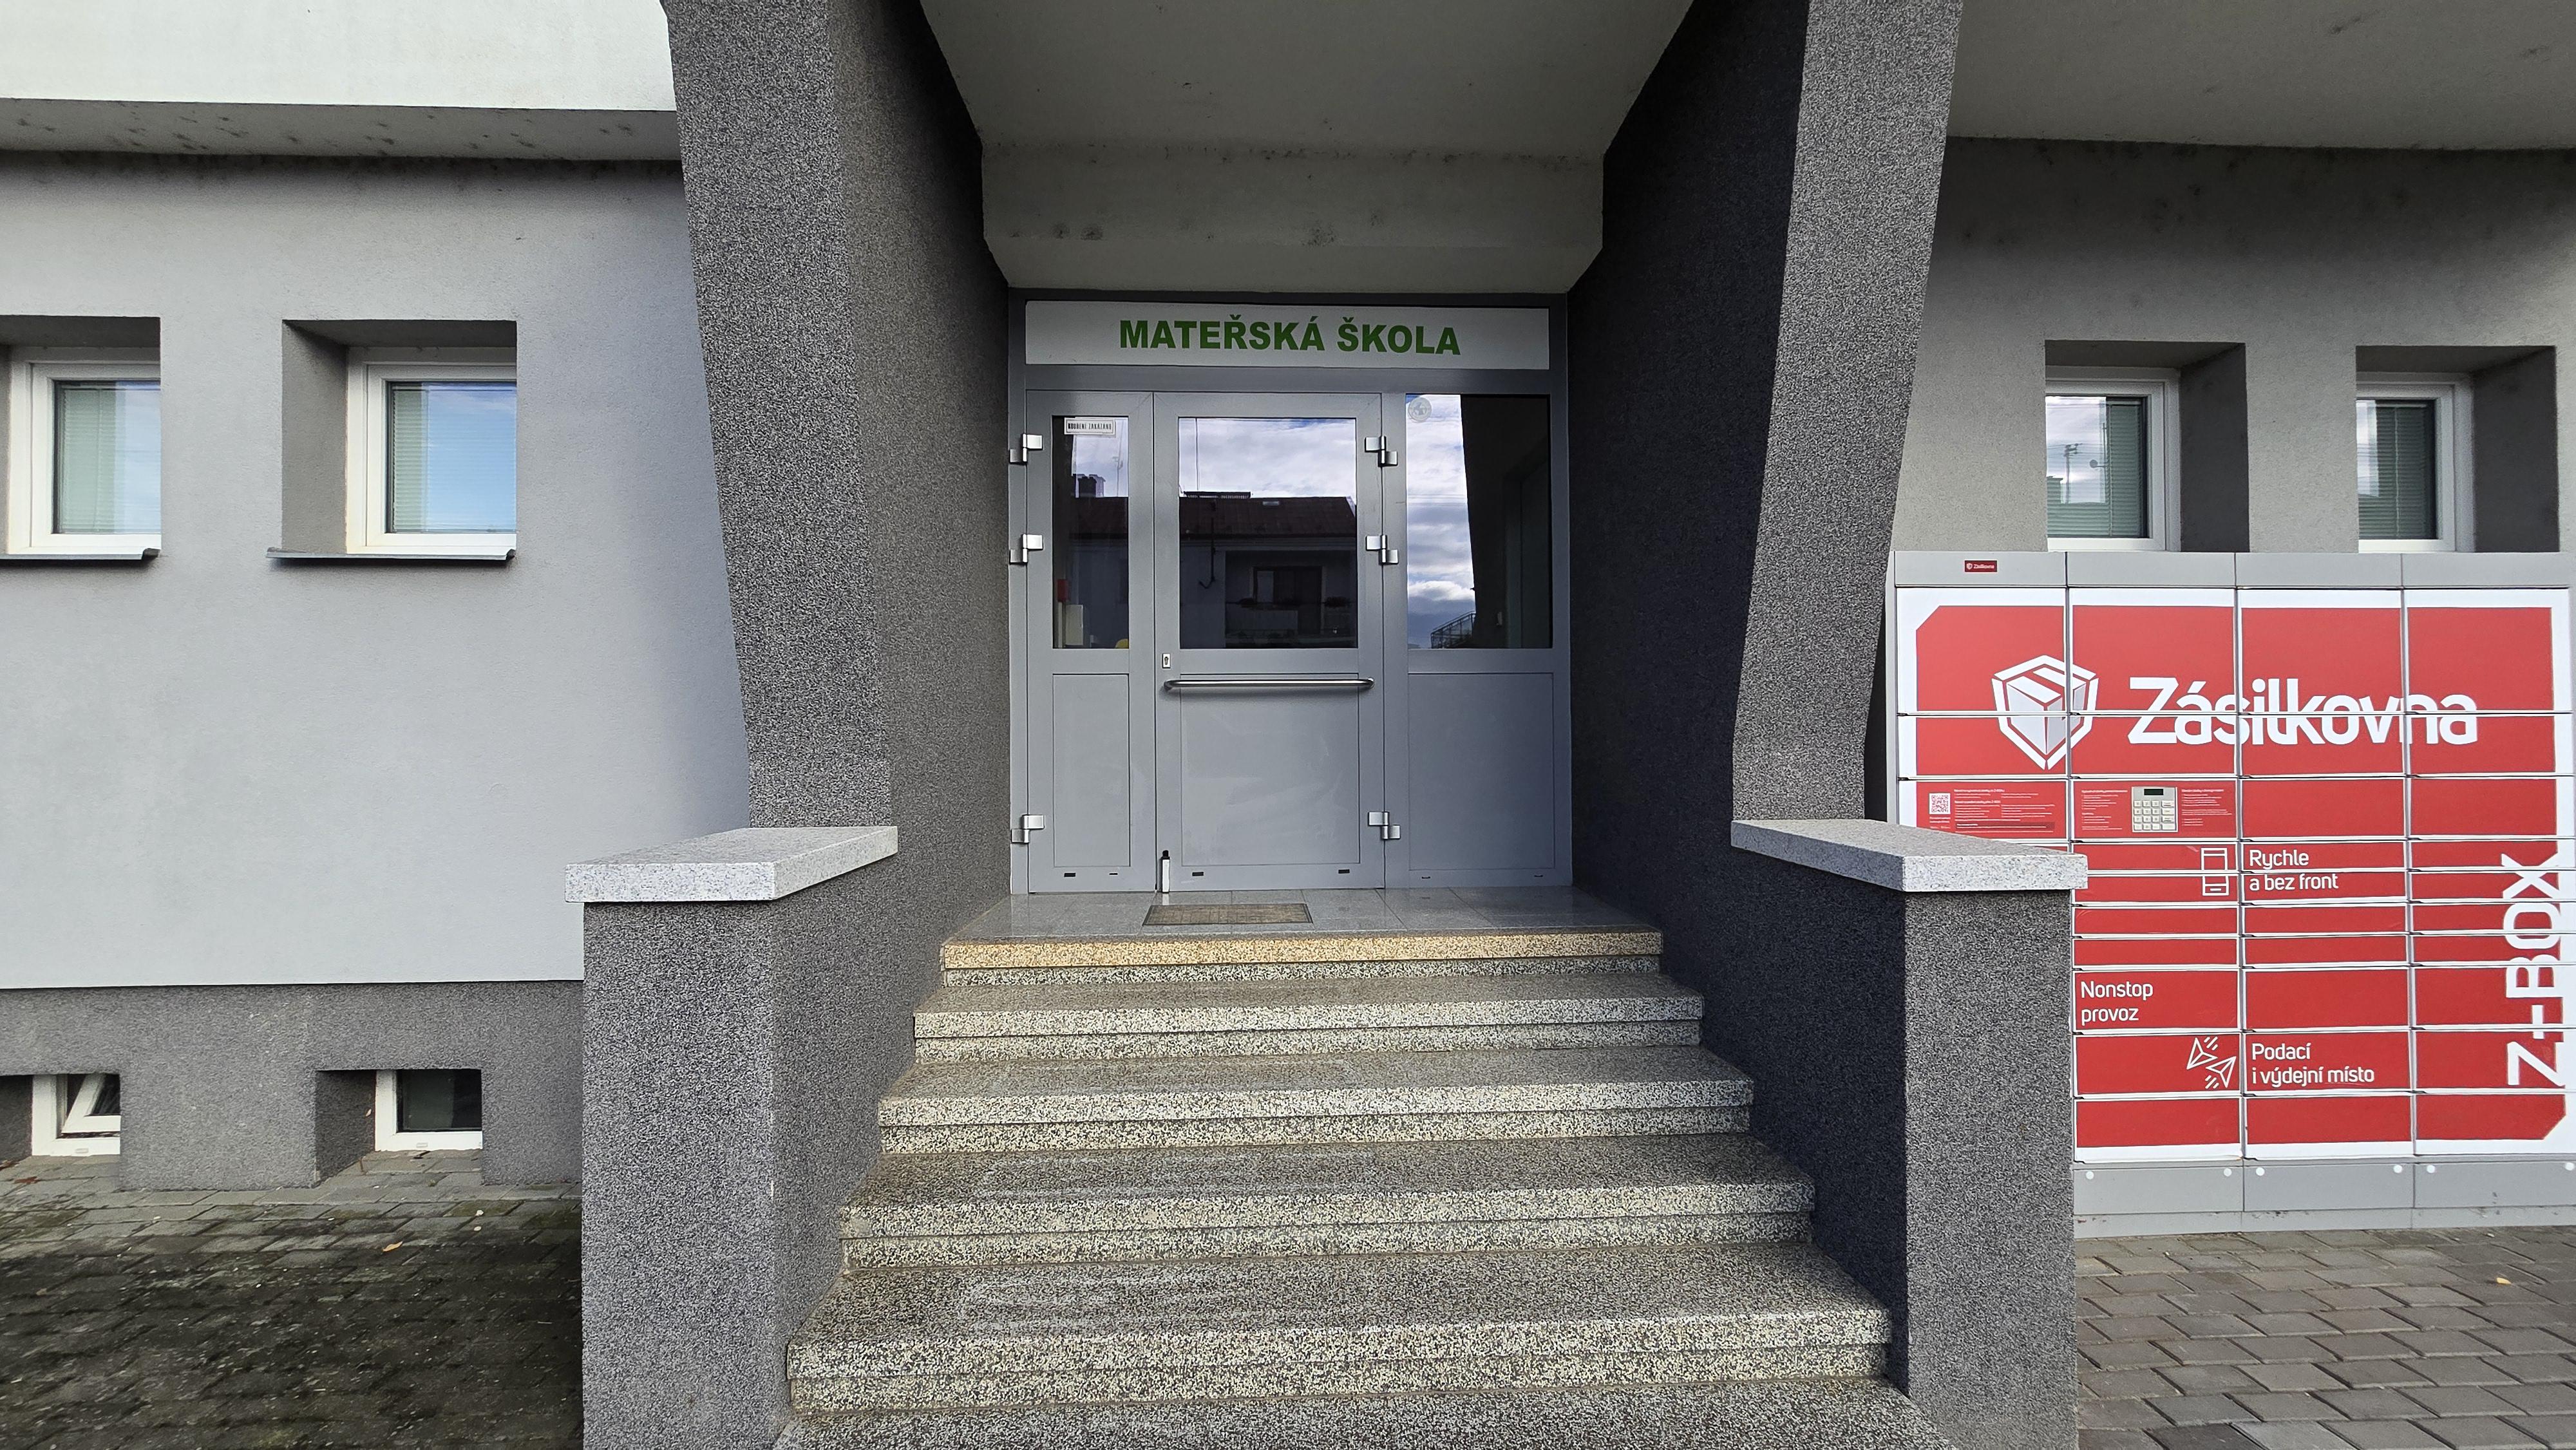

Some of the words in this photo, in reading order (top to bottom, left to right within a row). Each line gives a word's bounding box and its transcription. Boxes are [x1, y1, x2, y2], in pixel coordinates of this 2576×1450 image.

[1120, 314, 1325, 350] MATEŘSKÁ
[1337, 316, 1461, 355] ŠKOLA
[2127, 676, 2478, 746] Zásilkovna
[2249, 849, 2309, 870] Rychle
[2249, 878, 2260, 891] a
[2264, 874, 2295, 890] bez
[2299, 873, 2339, 890] front
[2501, 853, 2564, 1086] Z-BOX
[2081, 981, 2153, 1001] Nonstop
[2081, 1008, 2139, 1026] provoz
[2252, 1042, 2311, 1060] Podací
[2252, 1067, 2257, 1084] i
[2260, 1066, 2324, 1088] výdejní
[2327, 1066, 2375, 1082] místo
